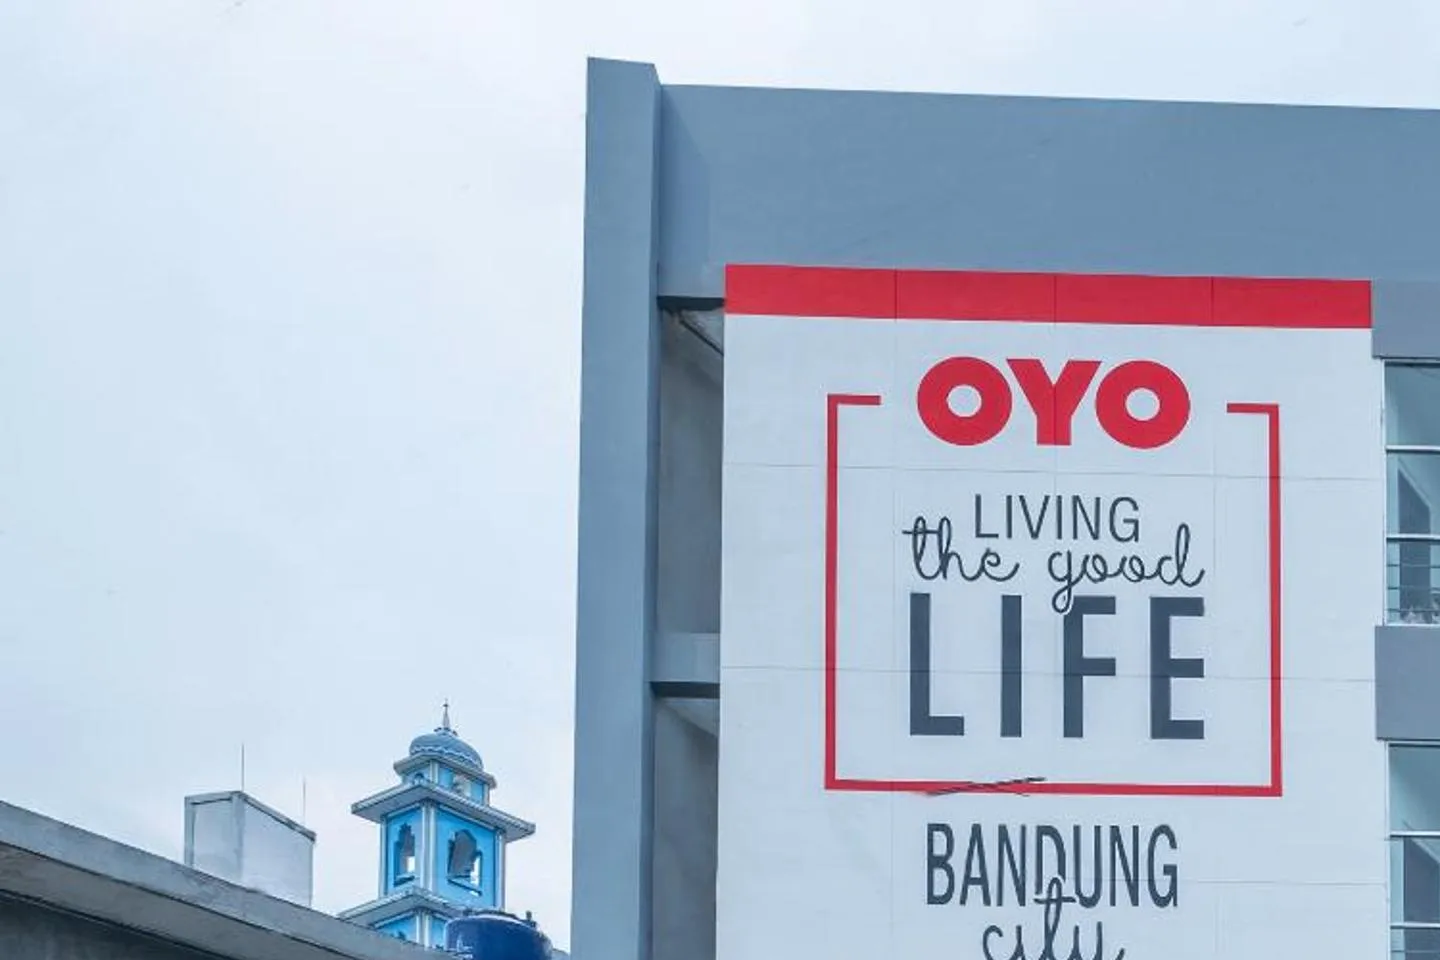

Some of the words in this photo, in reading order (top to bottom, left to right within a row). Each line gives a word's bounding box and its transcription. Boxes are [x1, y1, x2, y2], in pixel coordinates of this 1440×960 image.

[916, 356, 1191, 449] OYO
[902, 515, 1020, 582] the
[1046, 522, 1206, 613] good
[973, 494, 1141, 543] LIVING
[909, 592, 1205, 740] LIFE
[925, 823, 1179, 908] BANDUNG
